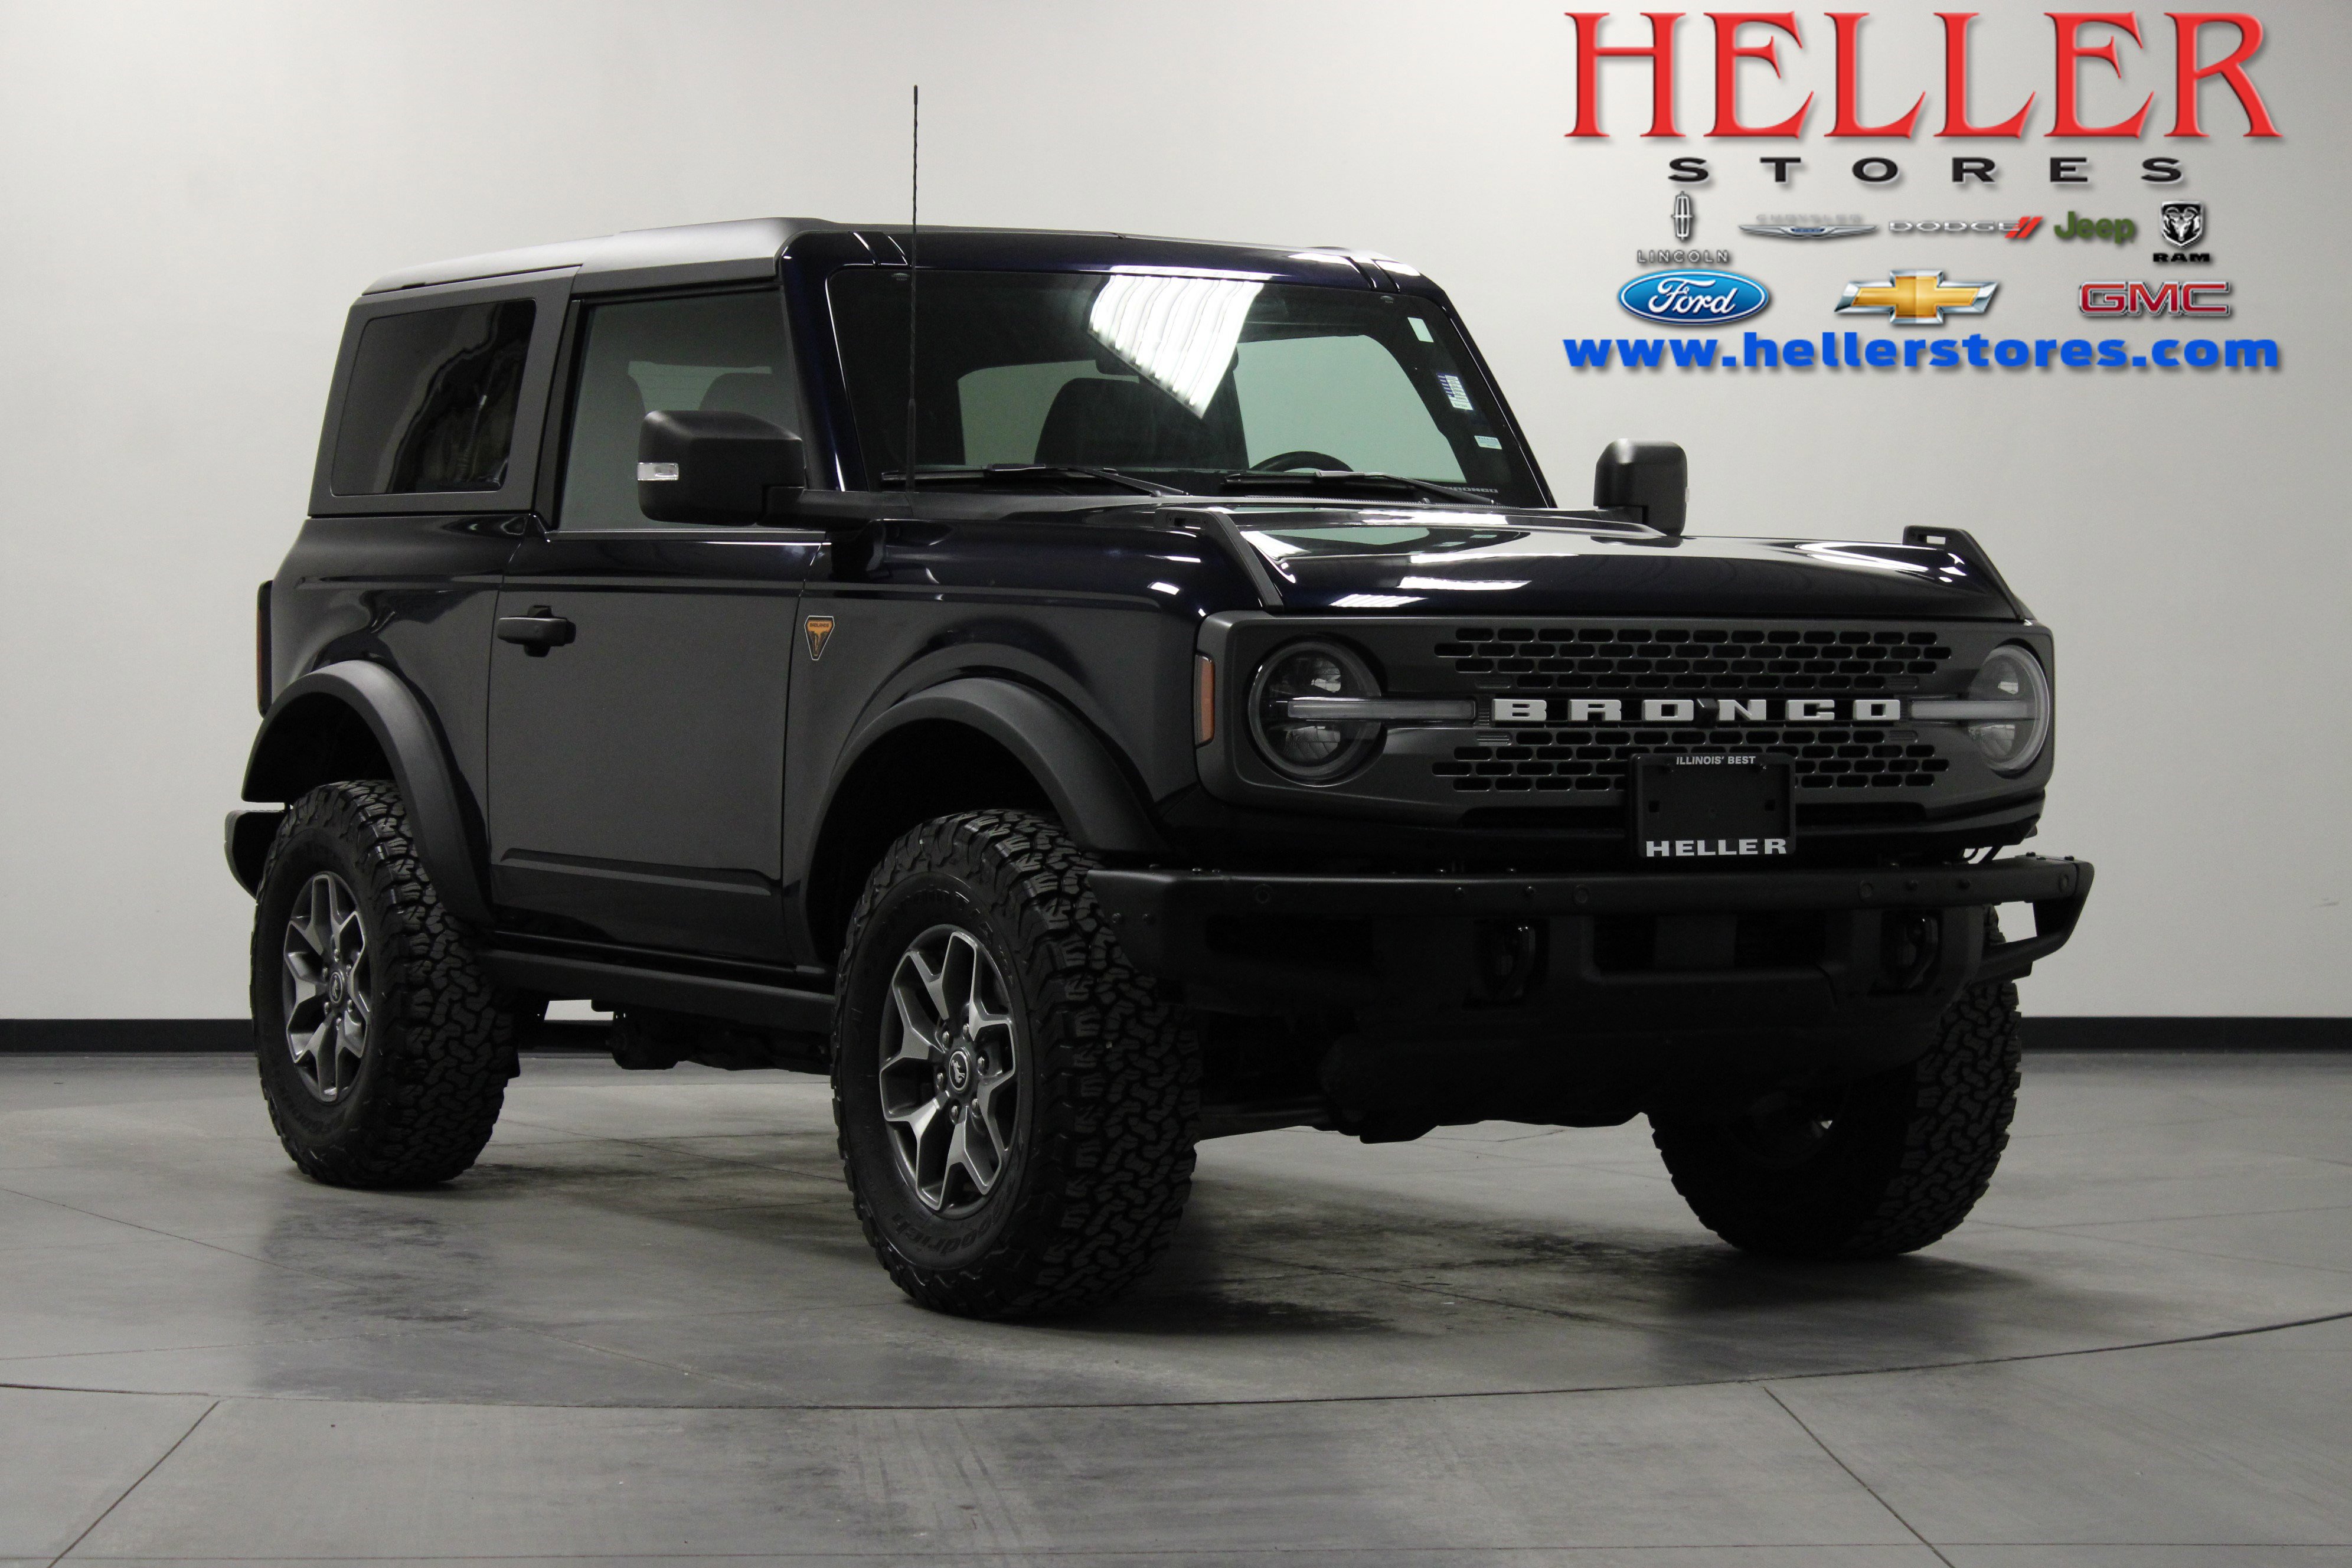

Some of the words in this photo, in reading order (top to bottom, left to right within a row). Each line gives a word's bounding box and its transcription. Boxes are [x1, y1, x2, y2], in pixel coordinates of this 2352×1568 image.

[1491, 699, 1901, 721] BRONCO
[1676, 756, 1724, 765] ILLINOIS'
[1727, 756, 1756, 765] BEST
[1646, 838, 1787, 857] HELLER
